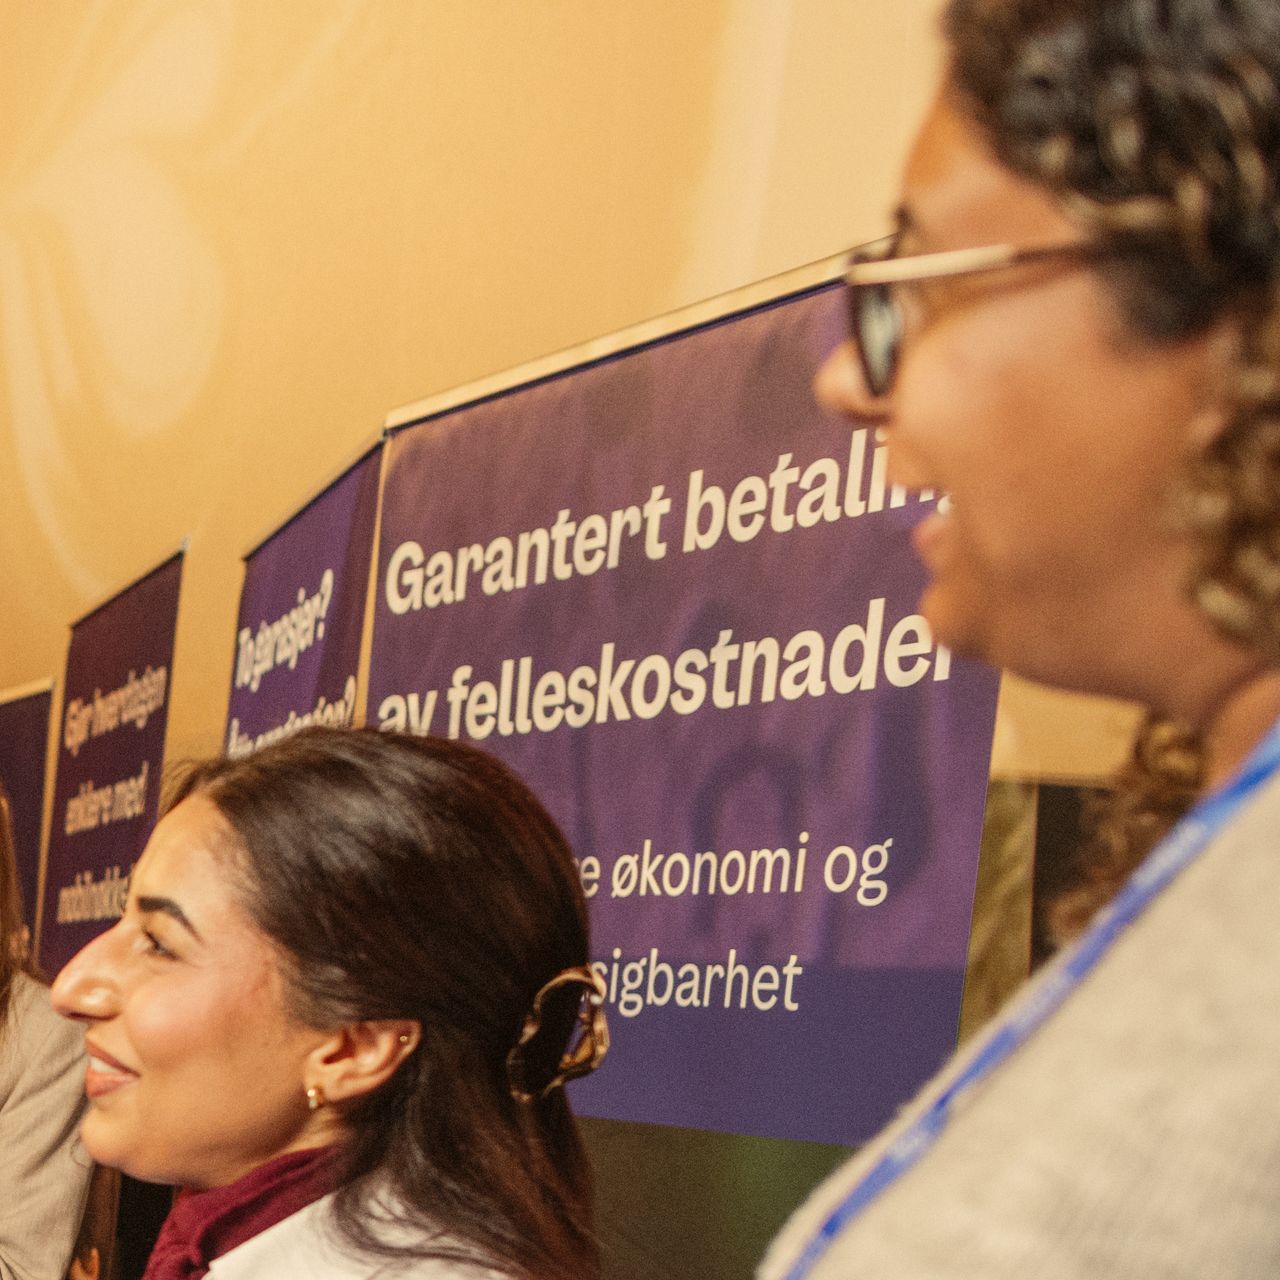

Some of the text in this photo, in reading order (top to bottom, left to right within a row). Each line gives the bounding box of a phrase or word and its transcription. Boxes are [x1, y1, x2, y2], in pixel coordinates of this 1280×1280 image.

[384, 428, 951, 616] Garantert betali
[378, 689, 438, 737] av
[610, 831, 810, 899] økonomi
[824, 838, 894, 907] og
[591, 947, 804, 1018] igbarhet
